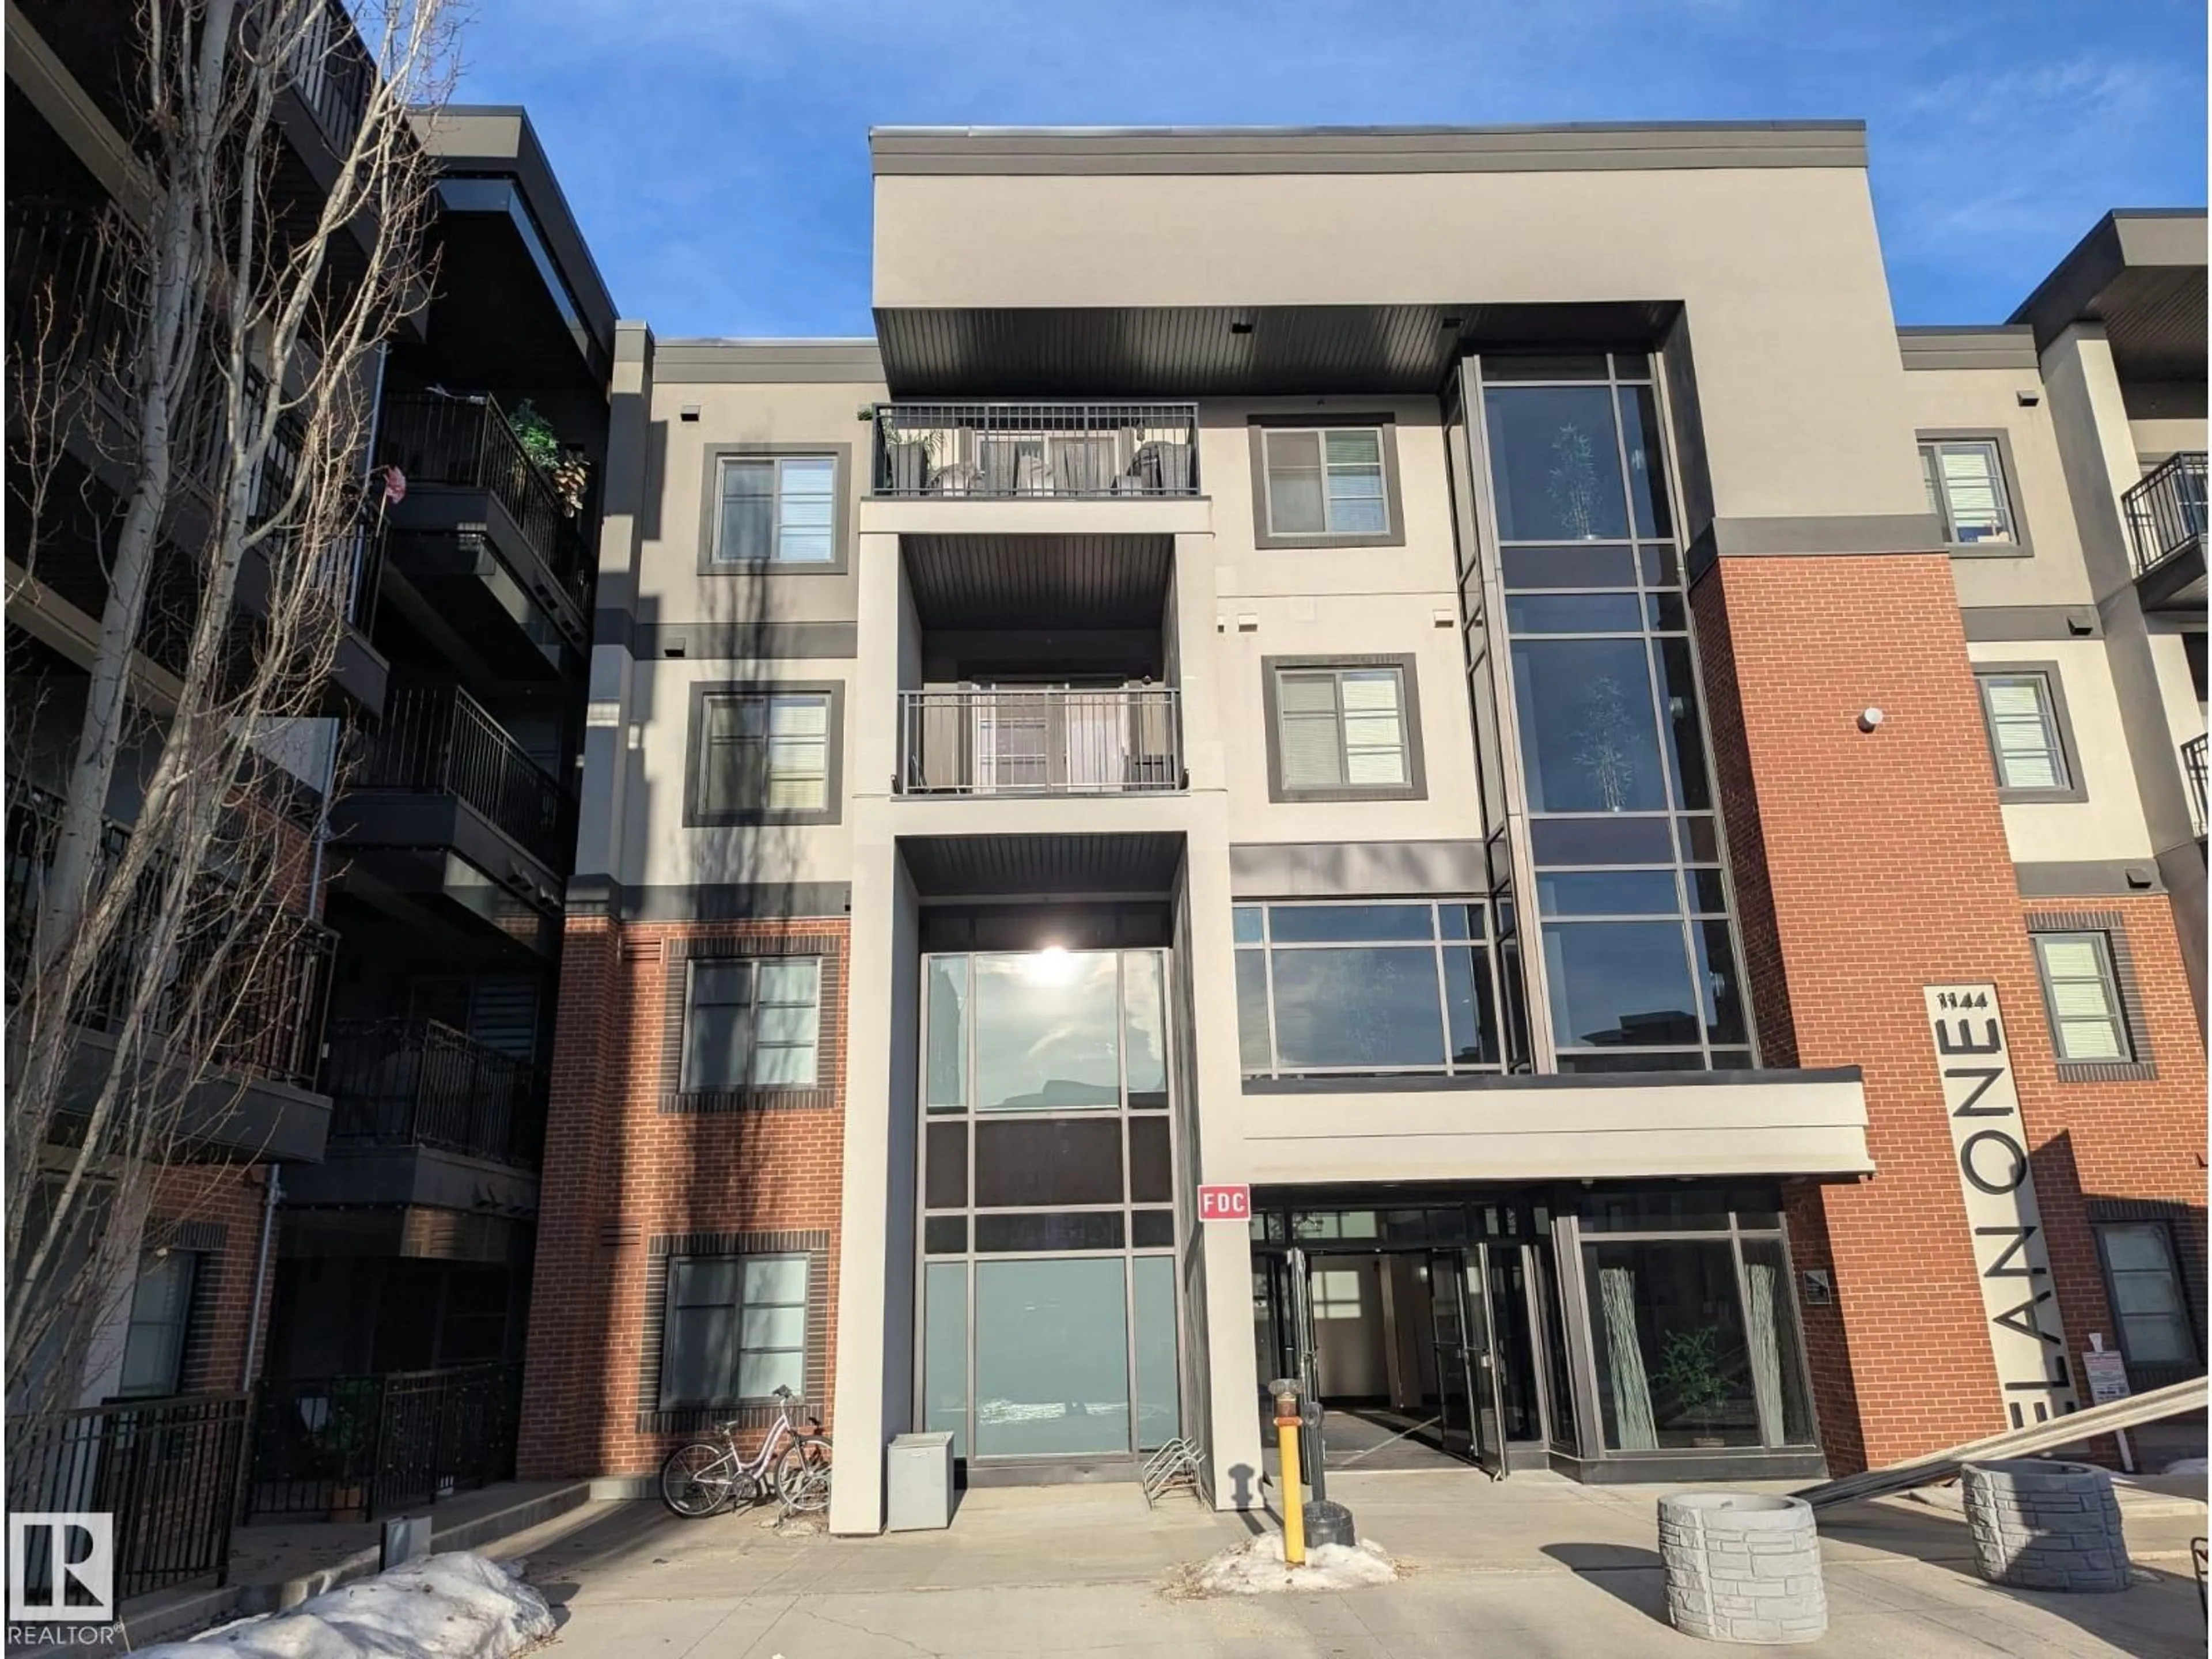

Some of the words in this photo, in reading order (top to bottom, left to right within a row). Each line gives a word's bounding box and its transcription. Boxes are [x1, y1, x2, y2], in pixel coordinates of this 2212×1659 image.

[1937, 992, 1987, 1010] 1144
[1935, 1018, 2027, 1194] ONE
[1204, 1193, 1245, 1212] FDC
